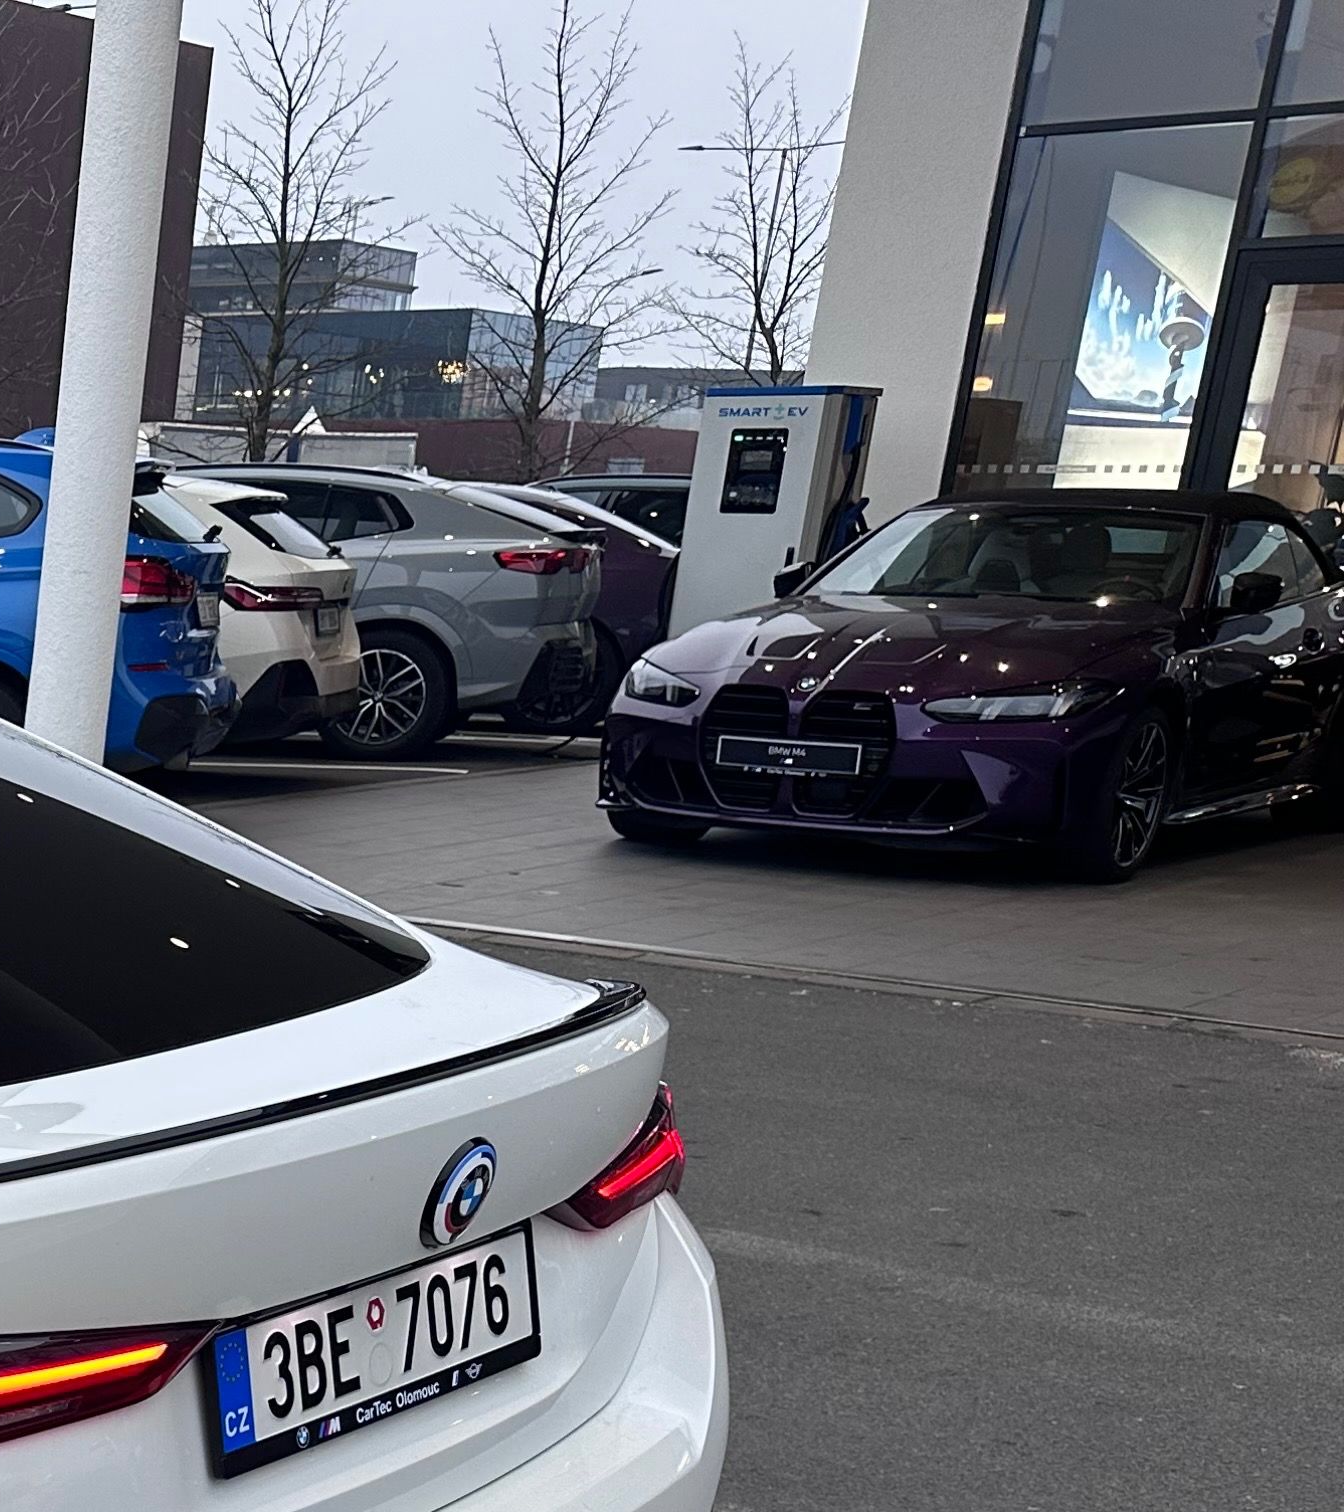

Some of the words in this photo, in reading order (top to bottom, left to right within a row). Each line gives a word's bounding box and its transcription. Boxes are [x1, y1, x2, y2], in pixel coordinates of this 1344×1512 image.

[718, 407, 771, 417] SMART
[787, 407, 809, 417] EV
[768, 746, 791, 756] BMW
[792, 747, 806, 757] M4
[263, 1305, 361, 1418] 3BE
[396, 1254, 510, 1373] 7076
[356, 1400, 392, 1424] CarTec
[396, 1383, 440, 1409] Olomouc
[224, 1406, 250, 1438] CZ
